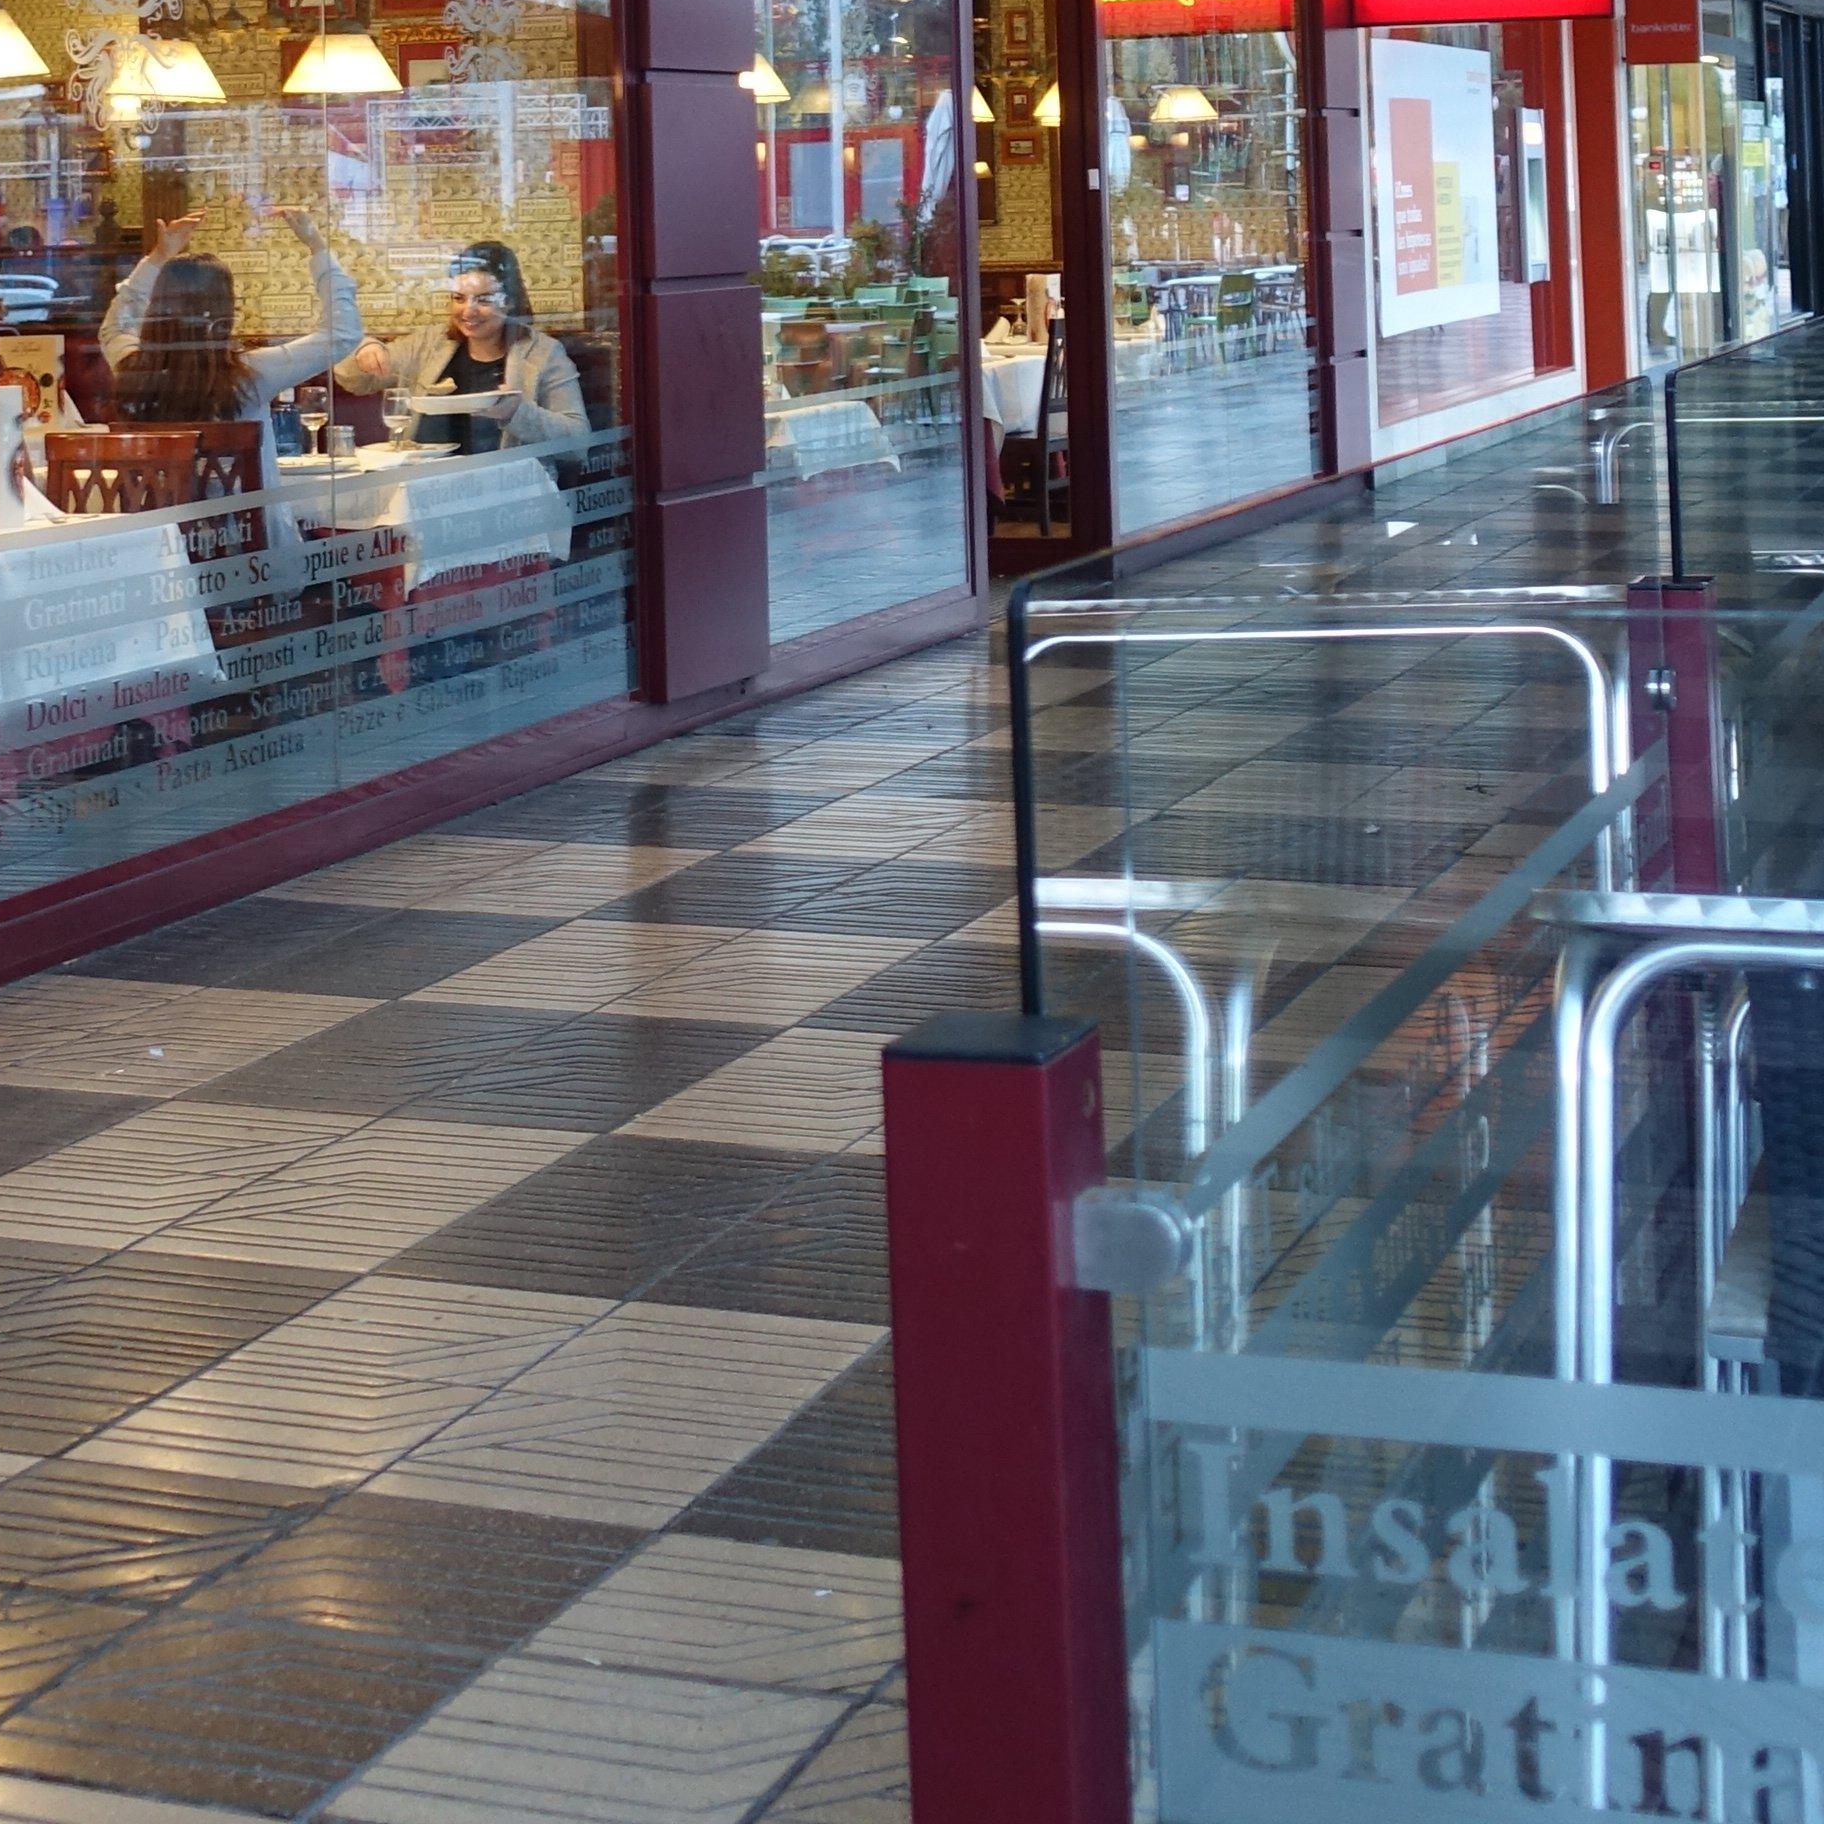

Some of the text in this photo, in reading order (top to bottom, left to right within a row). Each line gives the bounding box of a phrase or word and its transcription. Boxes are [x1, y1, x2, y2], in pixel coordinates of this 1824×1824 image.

[1630, 22, 1692, 34] bankinter
[148, 568, 226, 609] Risotto
[355, 541, 365, 563] e
[220, 596, 303, 639] Asciutta
[335, 575, 382, 611] Pizze
[25, 686, 88, 734] Dolci
[111, 667, 191, 712] Insalate
[315, 627, 357, 660] Pane
[25, 722, 129, 785] Gratinati
[150, 706, 228, 750] Risotto
[155, 756, 212, 796] Pasta
[223, 729, 305, 775] Asciutta
